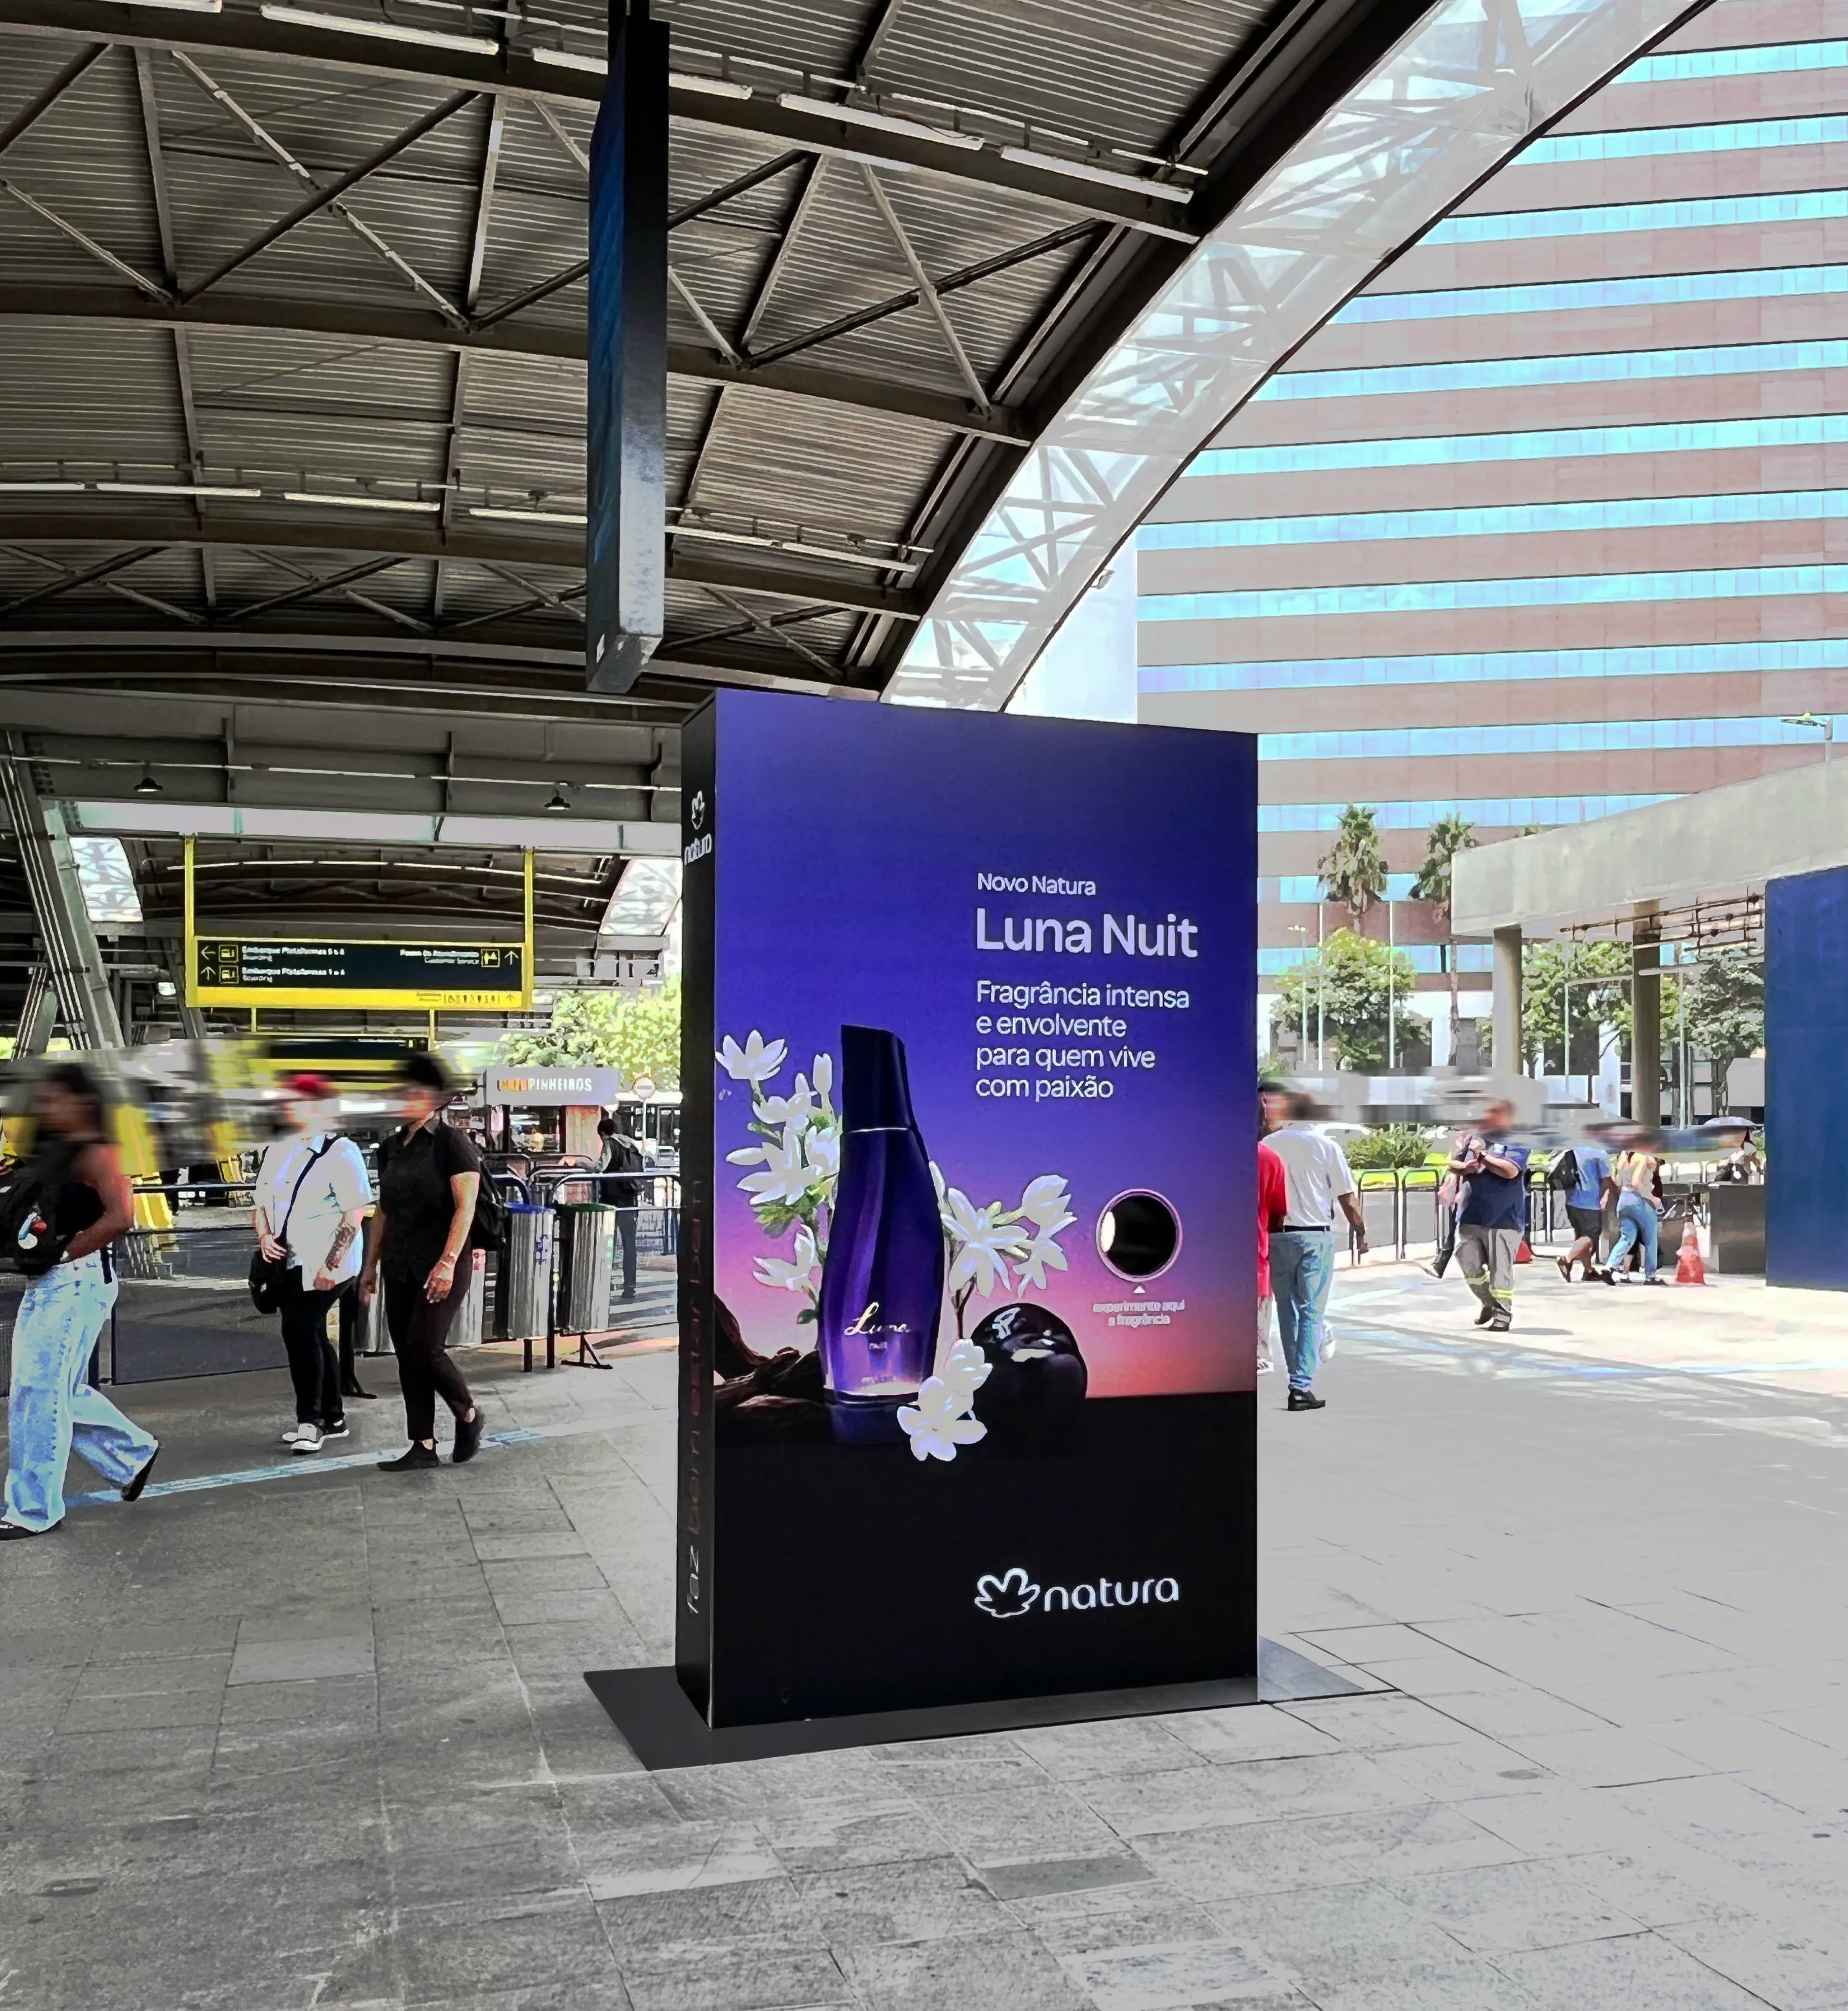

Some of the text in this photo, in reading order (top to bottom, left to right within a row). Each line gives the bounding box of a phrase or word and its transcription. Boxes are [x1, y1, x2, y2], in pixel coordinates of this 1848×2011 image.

[977, 872, 1096, 896] Novo Natura
[976, 907, 1198, 958] Luna Nuit
[977, 980, 1189, 1009] Fragrância intensa
[975, 1013, 1127, 1037] e envolvente
[976, 1045, 1156, 1071] para quem vive
[975, 1074, 1113, 1102] com paixão
[1044, 1577, 1179, 1612] natura
